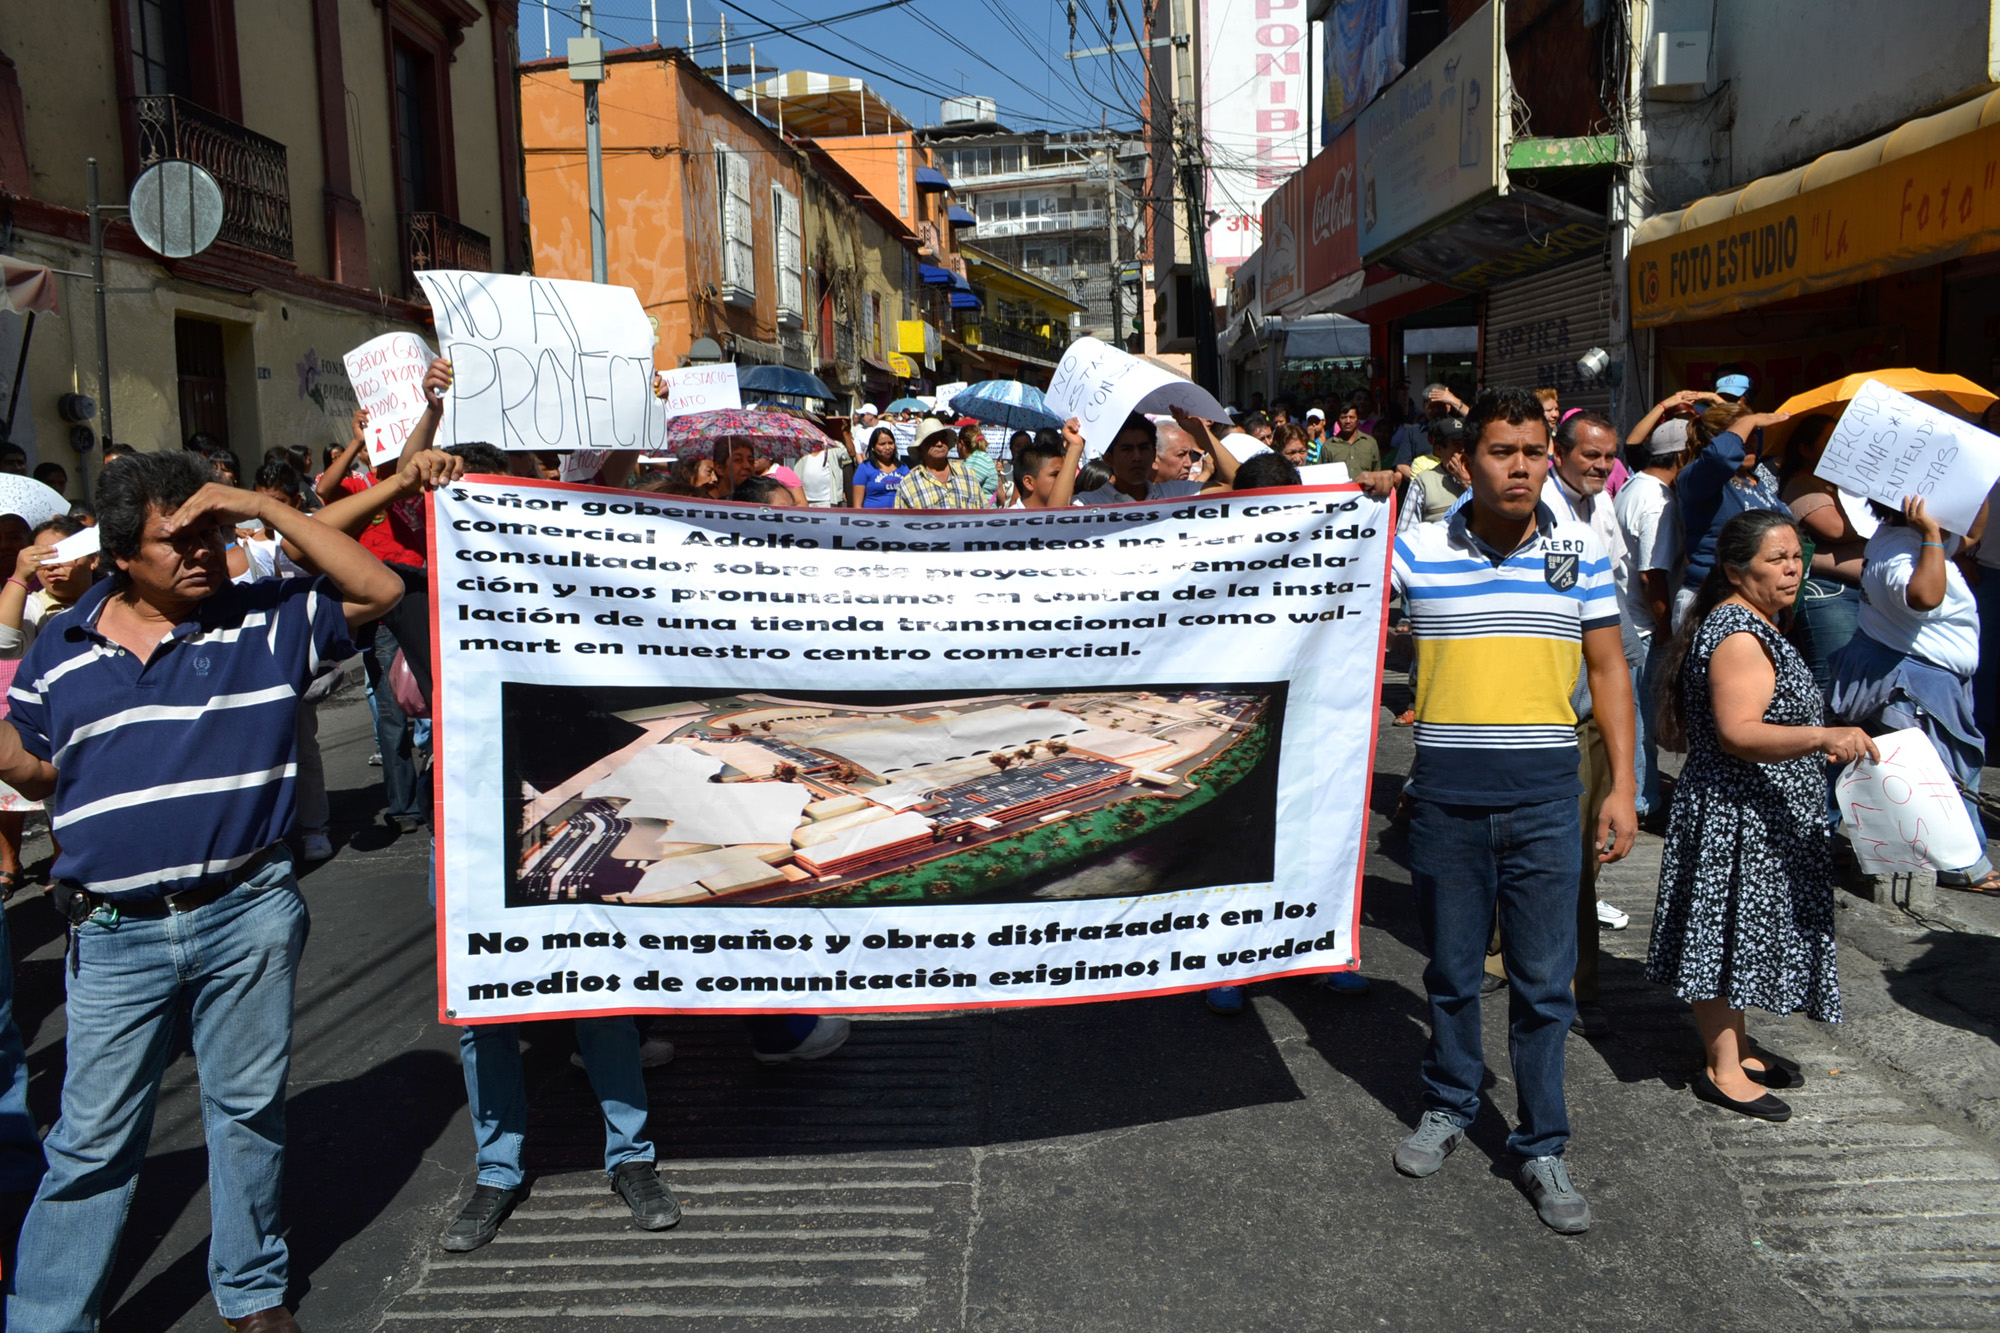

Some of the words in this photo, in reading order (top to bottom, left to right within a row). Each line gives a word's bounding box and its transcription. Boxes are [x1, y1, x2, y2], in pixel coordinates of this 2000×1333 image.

[1670, 243, 1712, 298] FOTO
[1717, 214, 1798, 288] ESTUDIO
[427, 273, 502, 340] NO
[530, 280, 609, 354] AL
[321, 359, 348, 377] FOND
[1053, 356, 1077, 396] NO
[448, 342, 667, 450] PROYECTO
[452, 488, 568, 511] Señor
[581, 501, 827, 525] gobernador
[840, 516, 892, 528] los
[904, 510, 1160, 531] comerciantes
[1171, 503, 1230, 520] del
[1242, 500, 1359, 516] centro
[452, 519, 656, 544] comercial
[681, 531, 819, 549] Adolfo
[832, 535, 951, 553] López
[964, 537, 1105, 551] mateos
[1118, 537, 1165, 549] no
[1309, 524, 1377, 541] sido
[1540, 539, 1584, 553] AERO
[455, 549, 698, 573] consultados
[713, 561, 819, 577] sobre
[926, 567, 1097, 581] proyecto
[1172, 553, 1359, 573] remodela-
[456, 576, 539, 594] ción
[552, 583, 577, 598] y
[589, 585, 657, 600] nos
[671, 588, 956, 605] pronunciamos
[974, 592, 1021, 604] en
[1033, 588, 1160, 604] contra
[1172, 585, 1217, 601] de
[1227, 583, 1260, 598] la
[1272, 581, 1372, 597] insta-
[458, 604, 581, 624] lación
[594, 610, 645, 626] de
[657, 617, 737, 631] una
[750, 616, 884, 632] tienda
[898, 613, 1167, 632] transnacional
[1178, 612, 1276, 627] como
[1288, 605, 1362, 624] wal-
[459, 638, 561, 654] mart
[574, 642, 624, 655] en
[637, 645, 791, 659] nuestro
[803, 646, 931, 660] centro
[943, 641, 1142, 660] comercial.
[467, 931, 529, 955] No
[541, 931, 628, 950] mas
[638, 929, 813, 954] engaños
[825, 933, 851, 954] y
[862, 928, 976, 949] obras
[987, 909, 1210, 947] disfrazadas
[1220, 904, 1263, 927] en
[1273, 900, 1317, 921] los
[468, 970, 621, 1000] medios
[632, 970, 683, 992] de
[697, 965, 977, 992] comunicación
[989, 957, 1160, 986] exigimos
[1170, 951, 1206, 972] la
[1217, 930, 1336, 967] verdad
